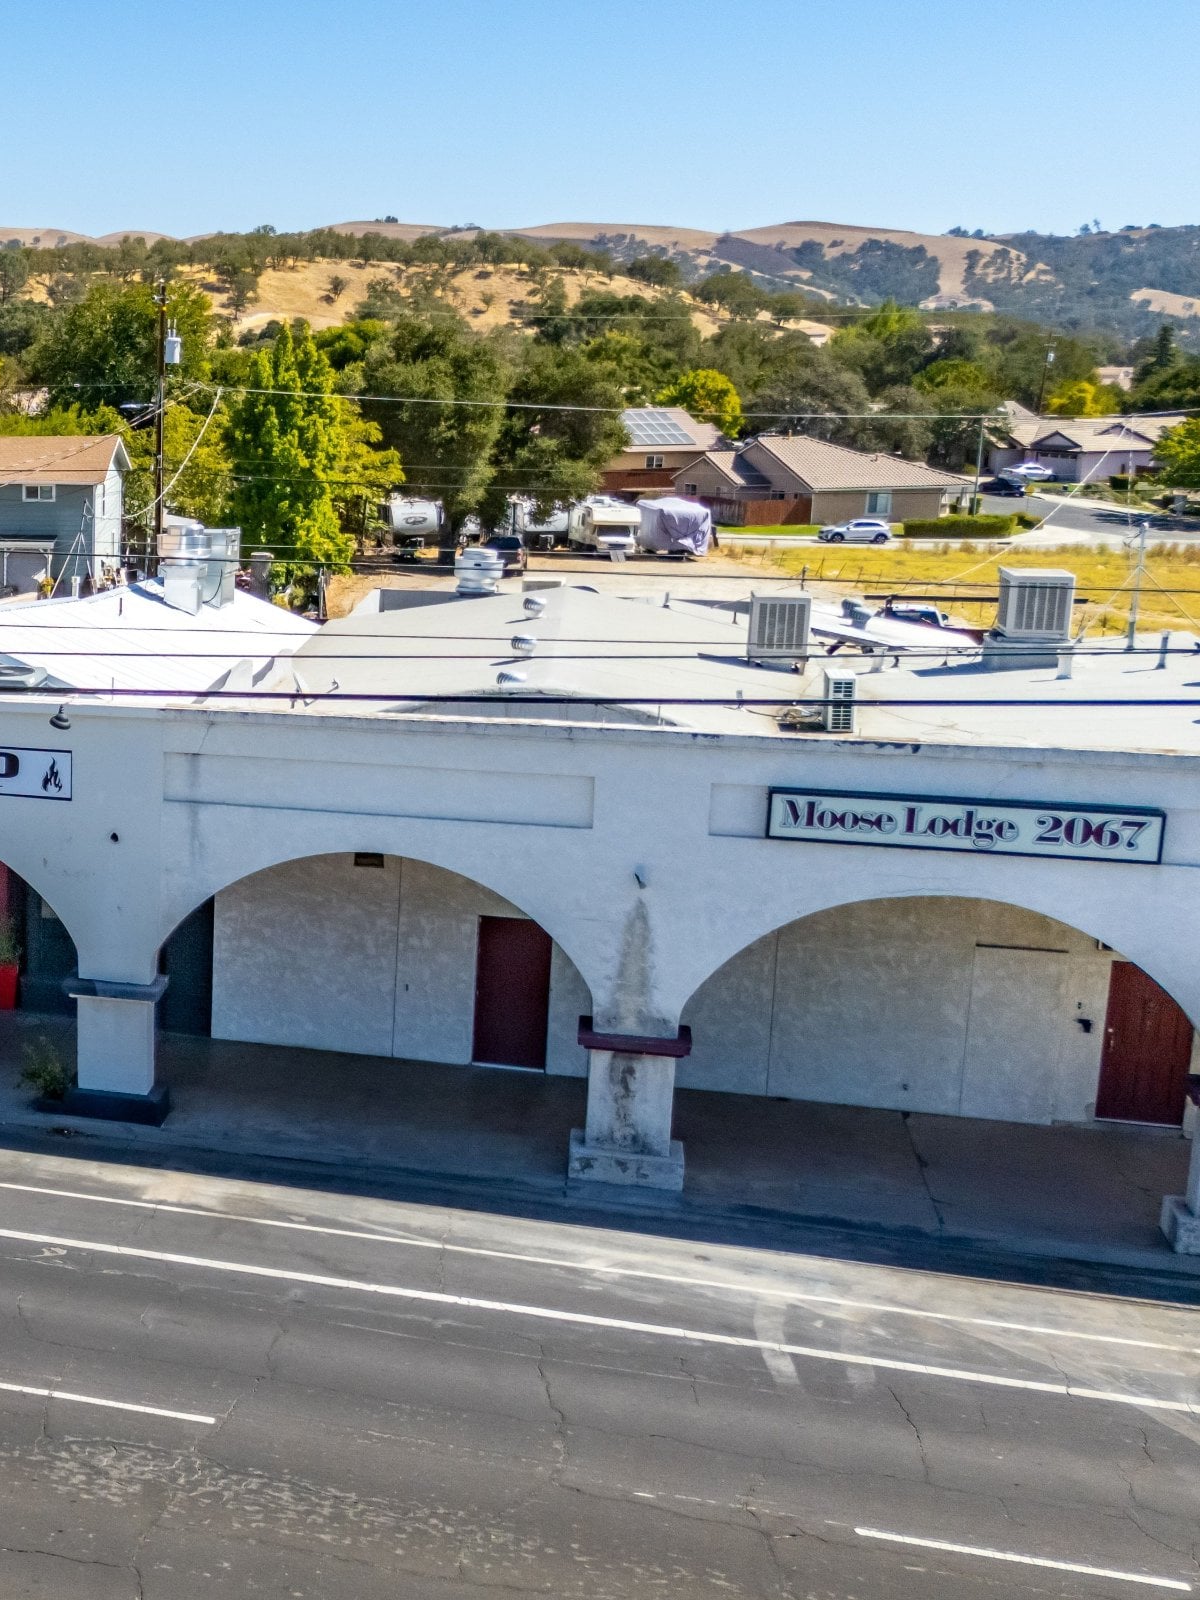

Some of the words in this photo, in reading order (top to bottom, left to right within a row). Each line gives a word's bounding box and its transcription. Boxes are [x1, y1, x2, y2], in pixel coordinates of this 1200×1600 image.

[779, 798, 896, 833] Moose
[900, 806, 1019, 849] Lodge
[1033, 815, 1152, 850] 2067
